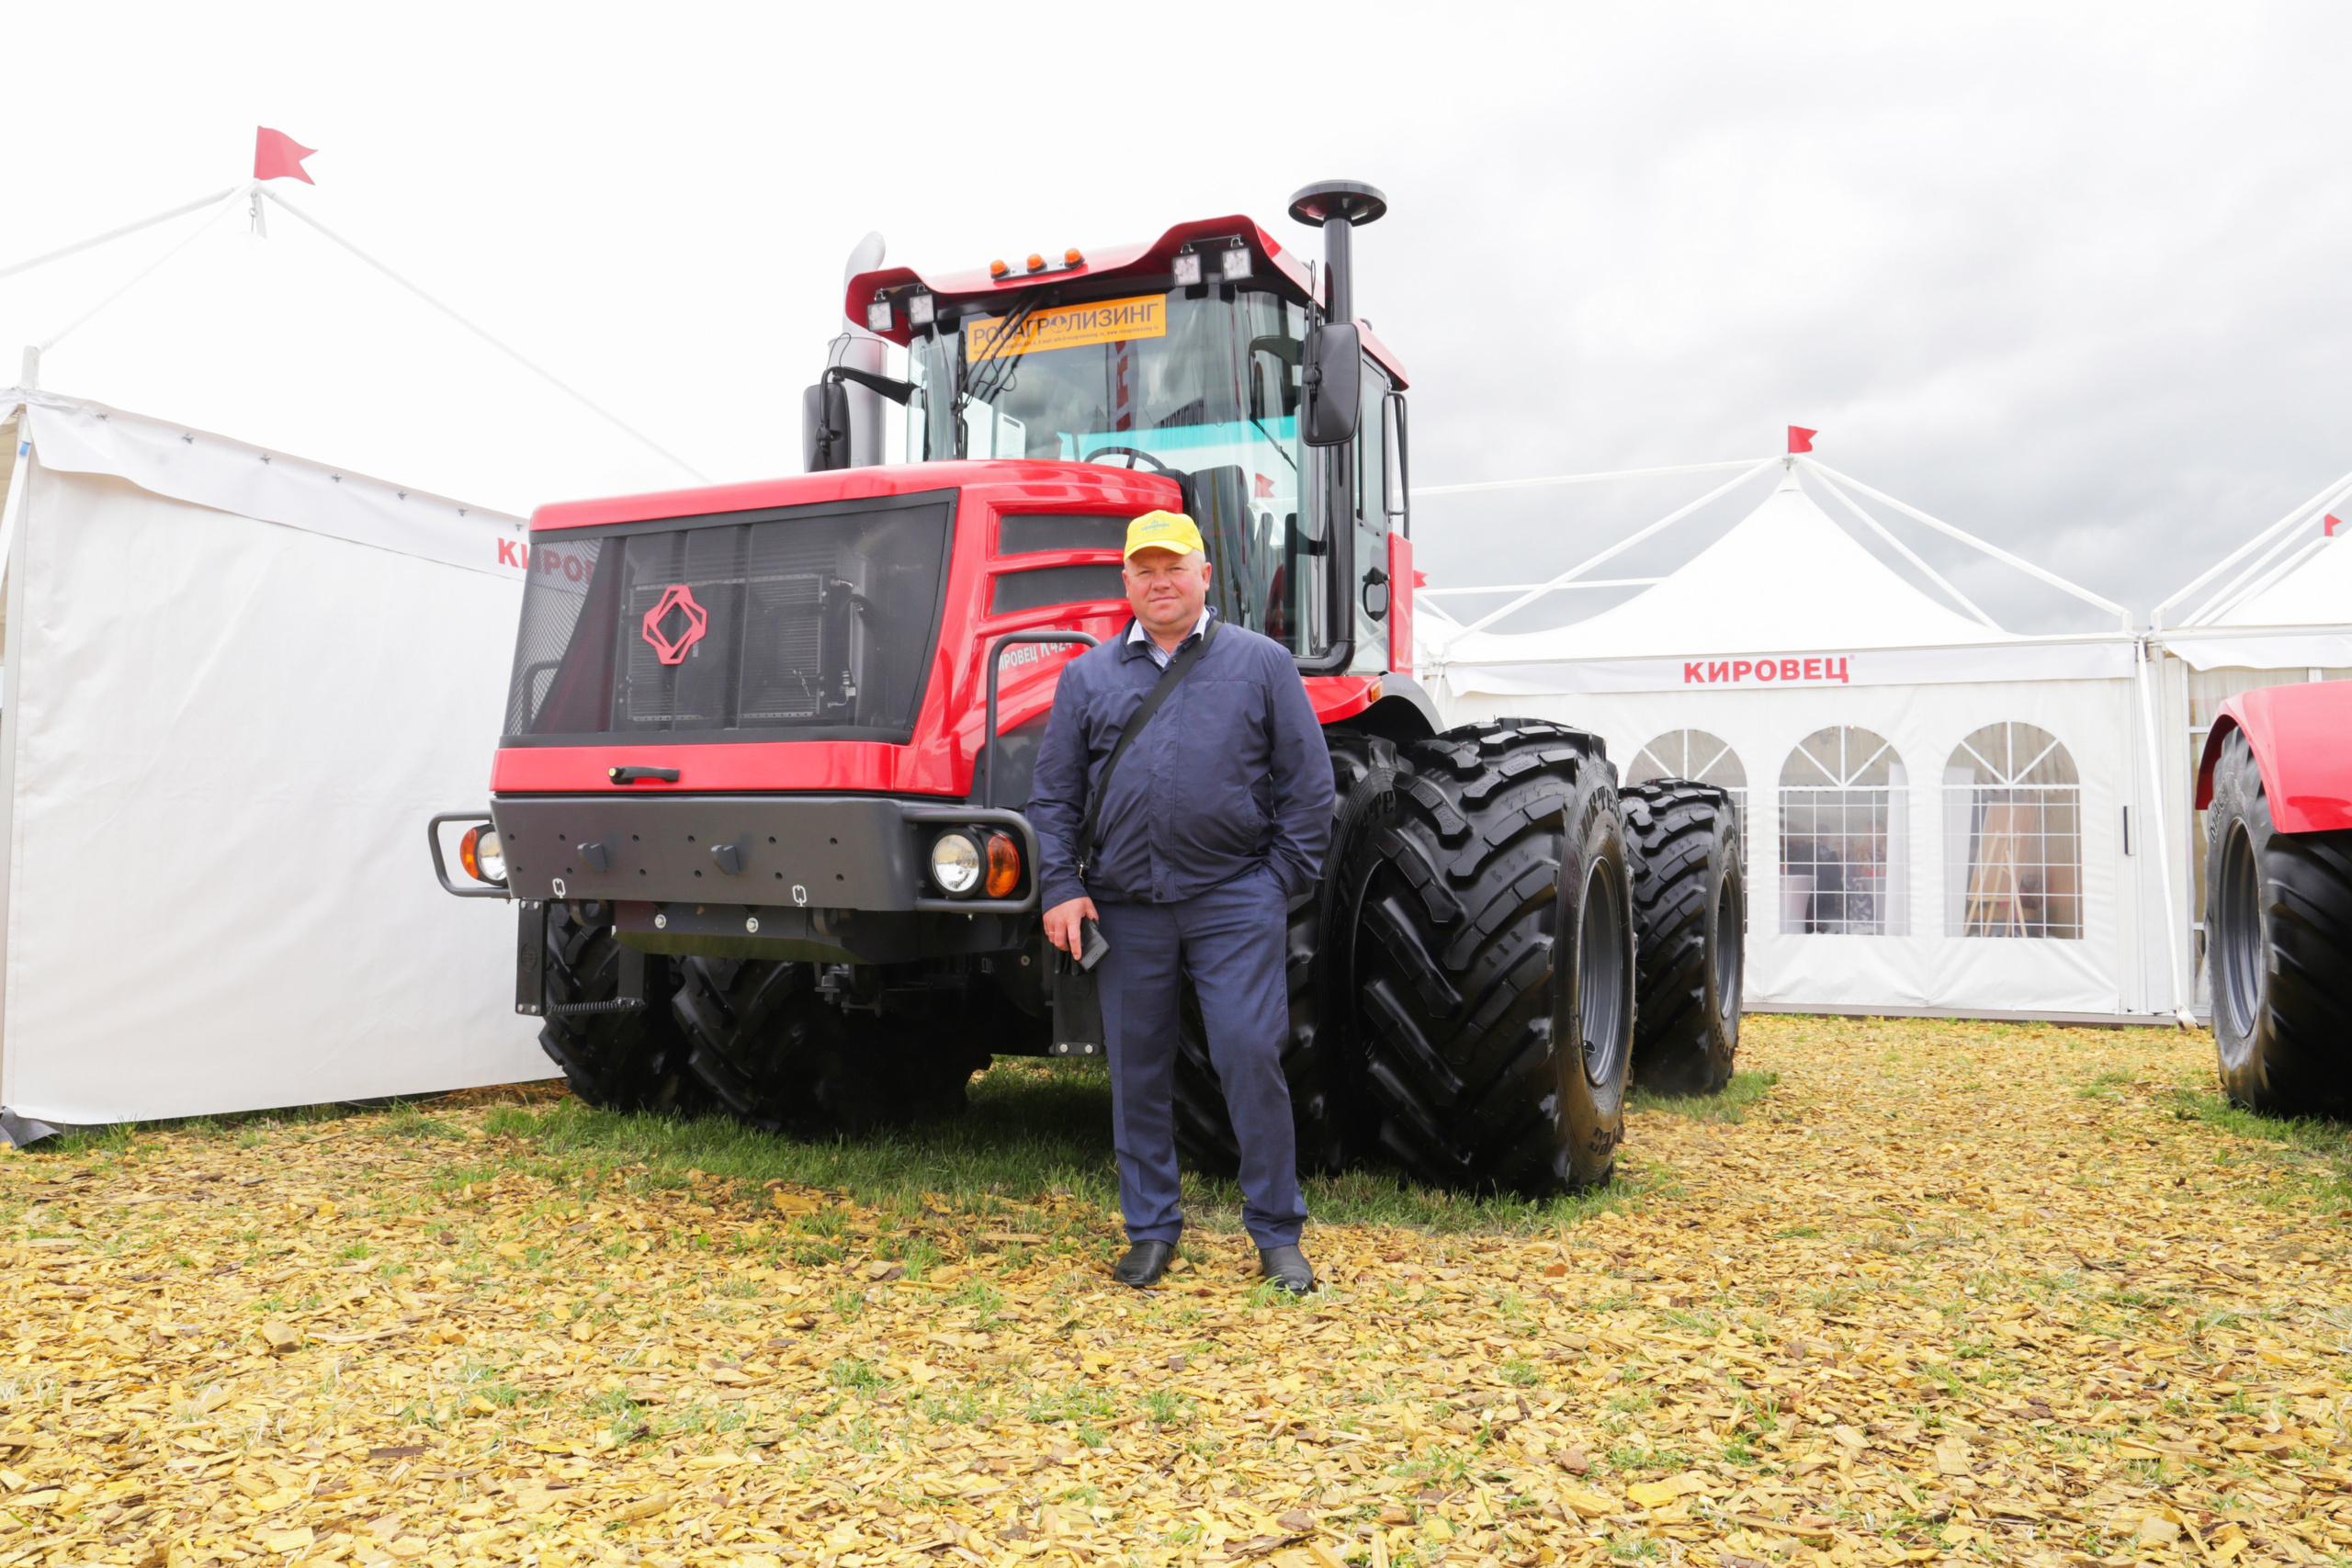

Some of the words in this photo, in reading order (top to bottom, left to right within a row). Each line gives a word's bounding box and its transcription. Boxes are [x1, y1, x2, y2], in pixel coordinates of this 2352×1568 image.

[497, 537, 596, 585] КИРО
[999, 645, 1038, 671] ИРОВЕЦ
[1684, 658, 1849, 683] КИРОВЕЦ
